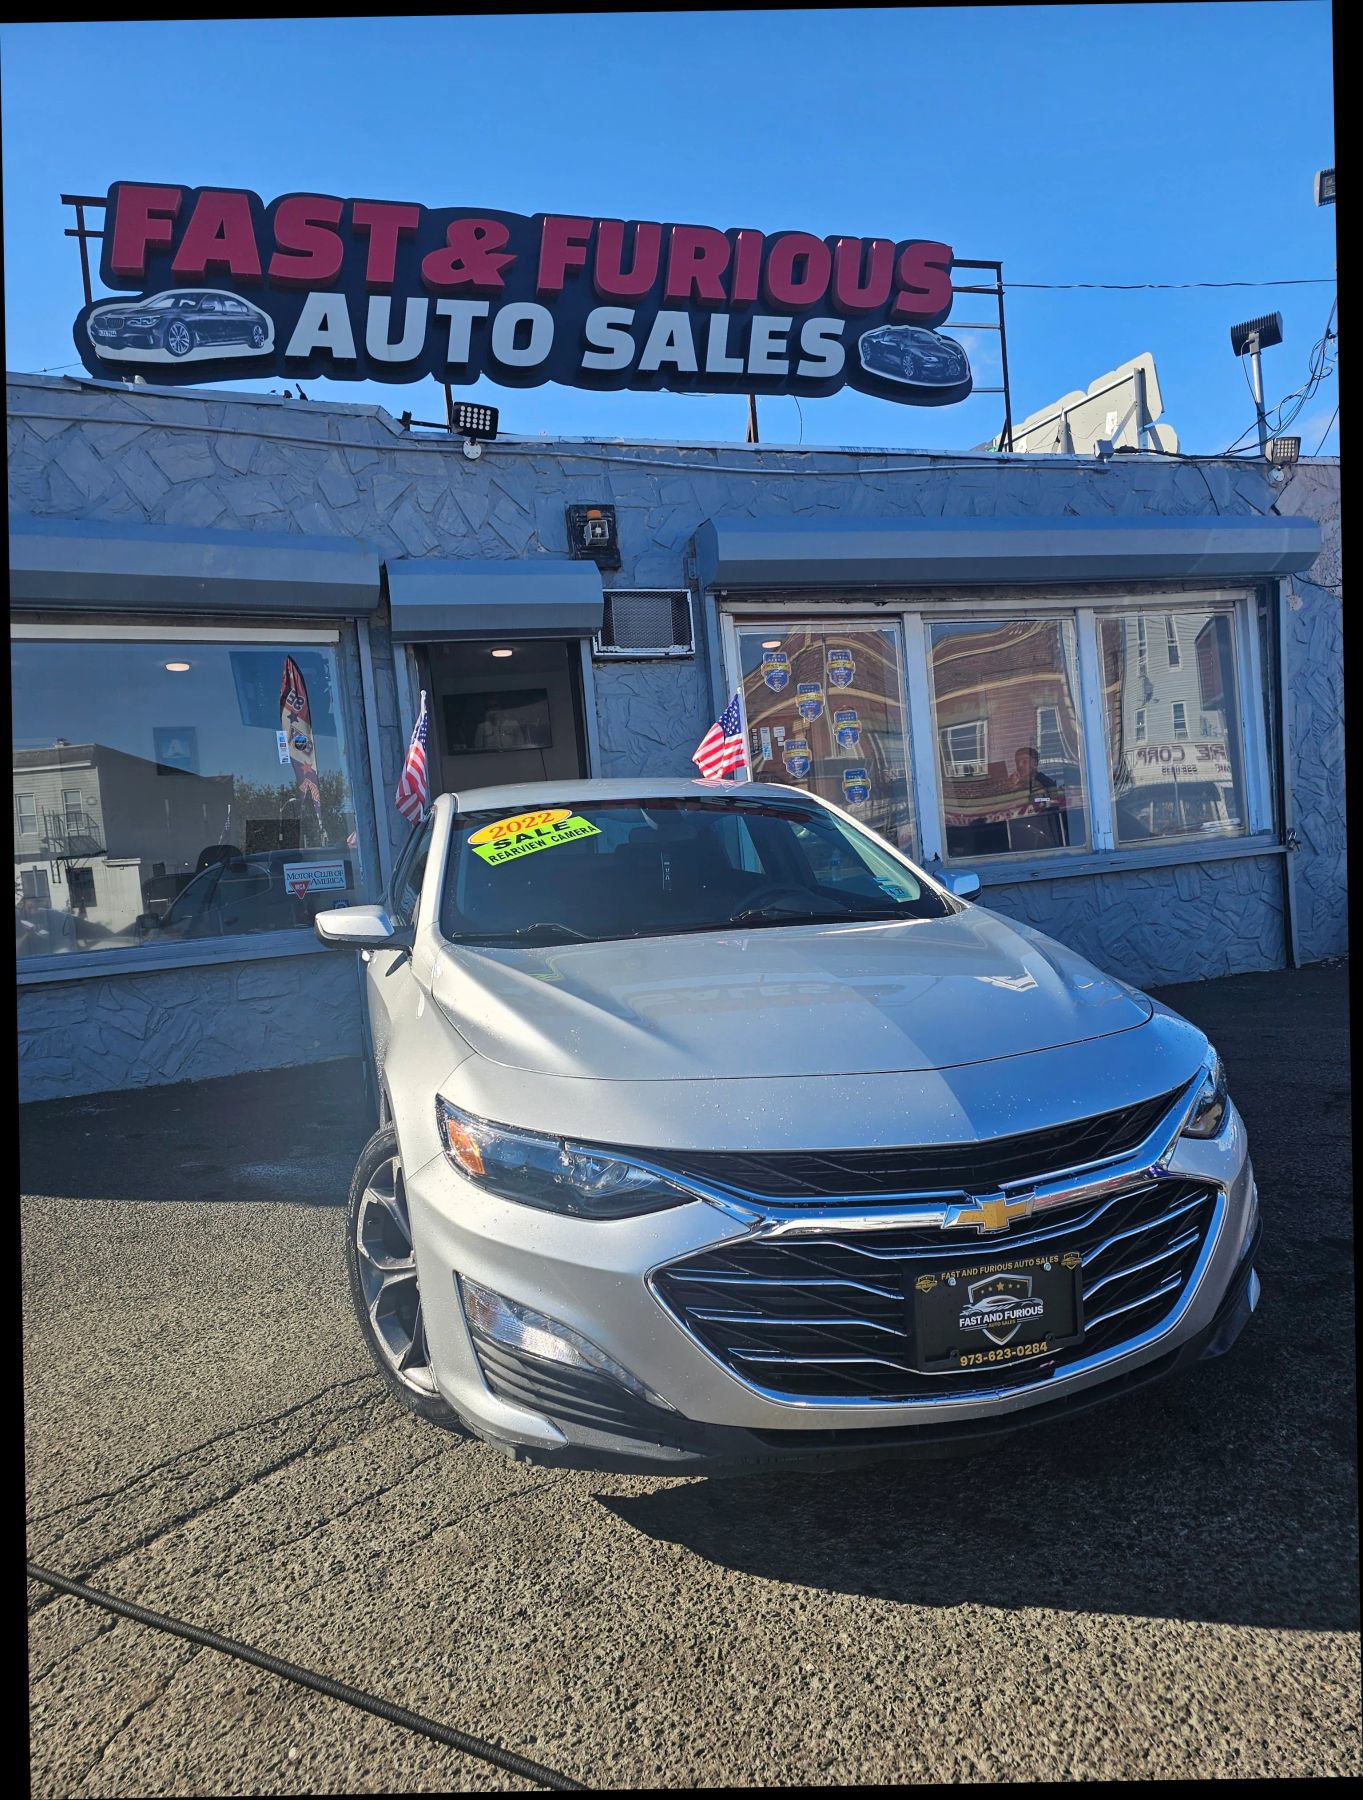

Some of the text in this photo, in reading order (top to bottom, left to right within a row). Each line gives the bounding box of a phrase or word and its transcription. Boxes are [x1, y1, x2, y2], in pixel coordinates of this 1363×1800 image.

[111, 184, 953, 317] FAST & FURIOUS
[286, 292, 846, 378] AUTO SALES
[489, 812, 555, 840] 2022
[493, 821, 571, 851] SALE
[488, 825, 597, 863] REARVIEW CAMERA
[286, 872, 314, 881] MOTOR
[310, 877, 344, 885] AMERICA
[941, 1255, 1059, 1281] FAST AND FURIOUS AUTO SALES
[959, 1305, 1044, 1328] FAST AND FURIOUS
[960, 1341, 1048, 1367] 973-623-0284
